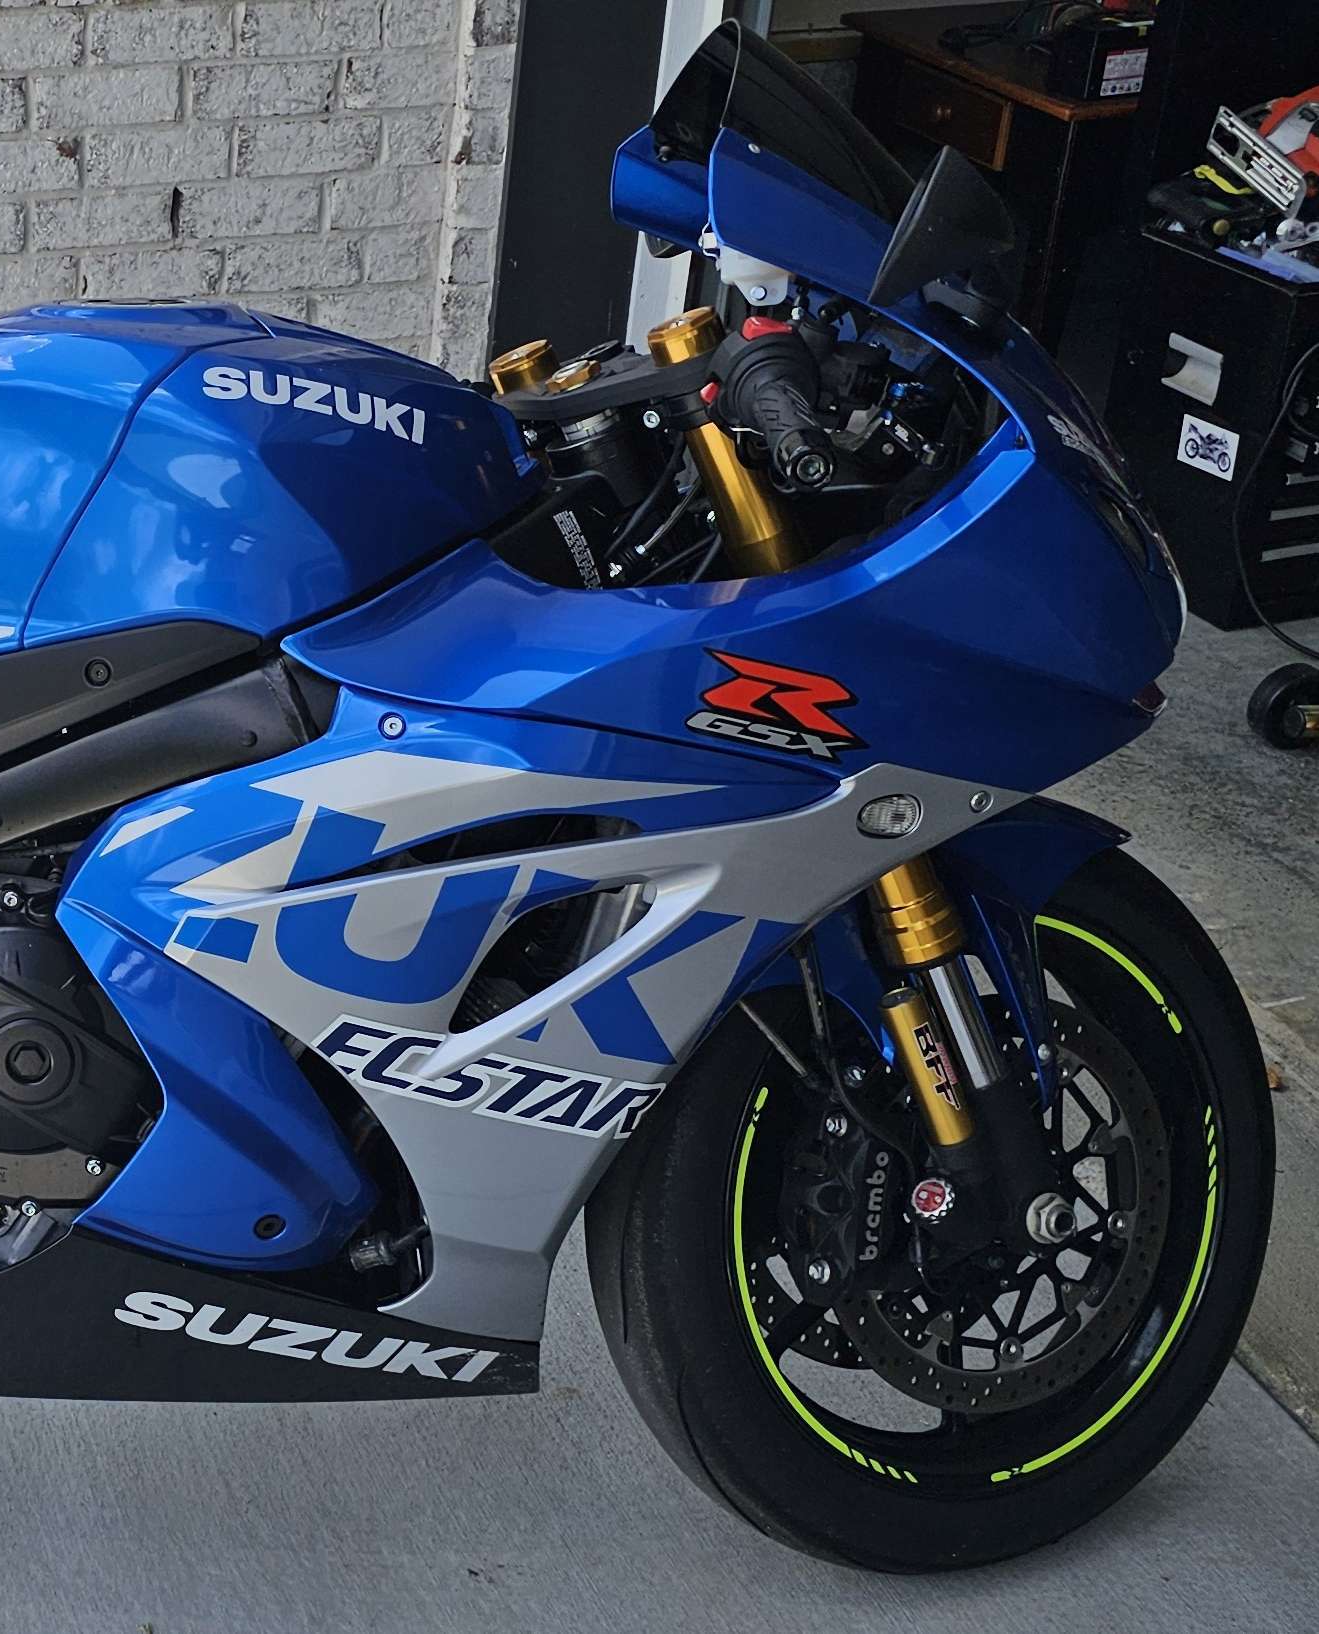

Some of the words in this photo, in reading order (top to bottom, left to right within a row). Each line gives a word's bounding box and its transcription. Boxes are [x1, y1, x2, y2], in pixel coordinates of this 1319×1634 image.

[202, 366, 426, 445] SUZUKI
[686, 710, 852, 760] GSX
[314, 1018, 664, 1136] ECSTAR
[859, 1151, 889, 1261] brembo
[114, 1291, 500, 1383] SUZUKI
